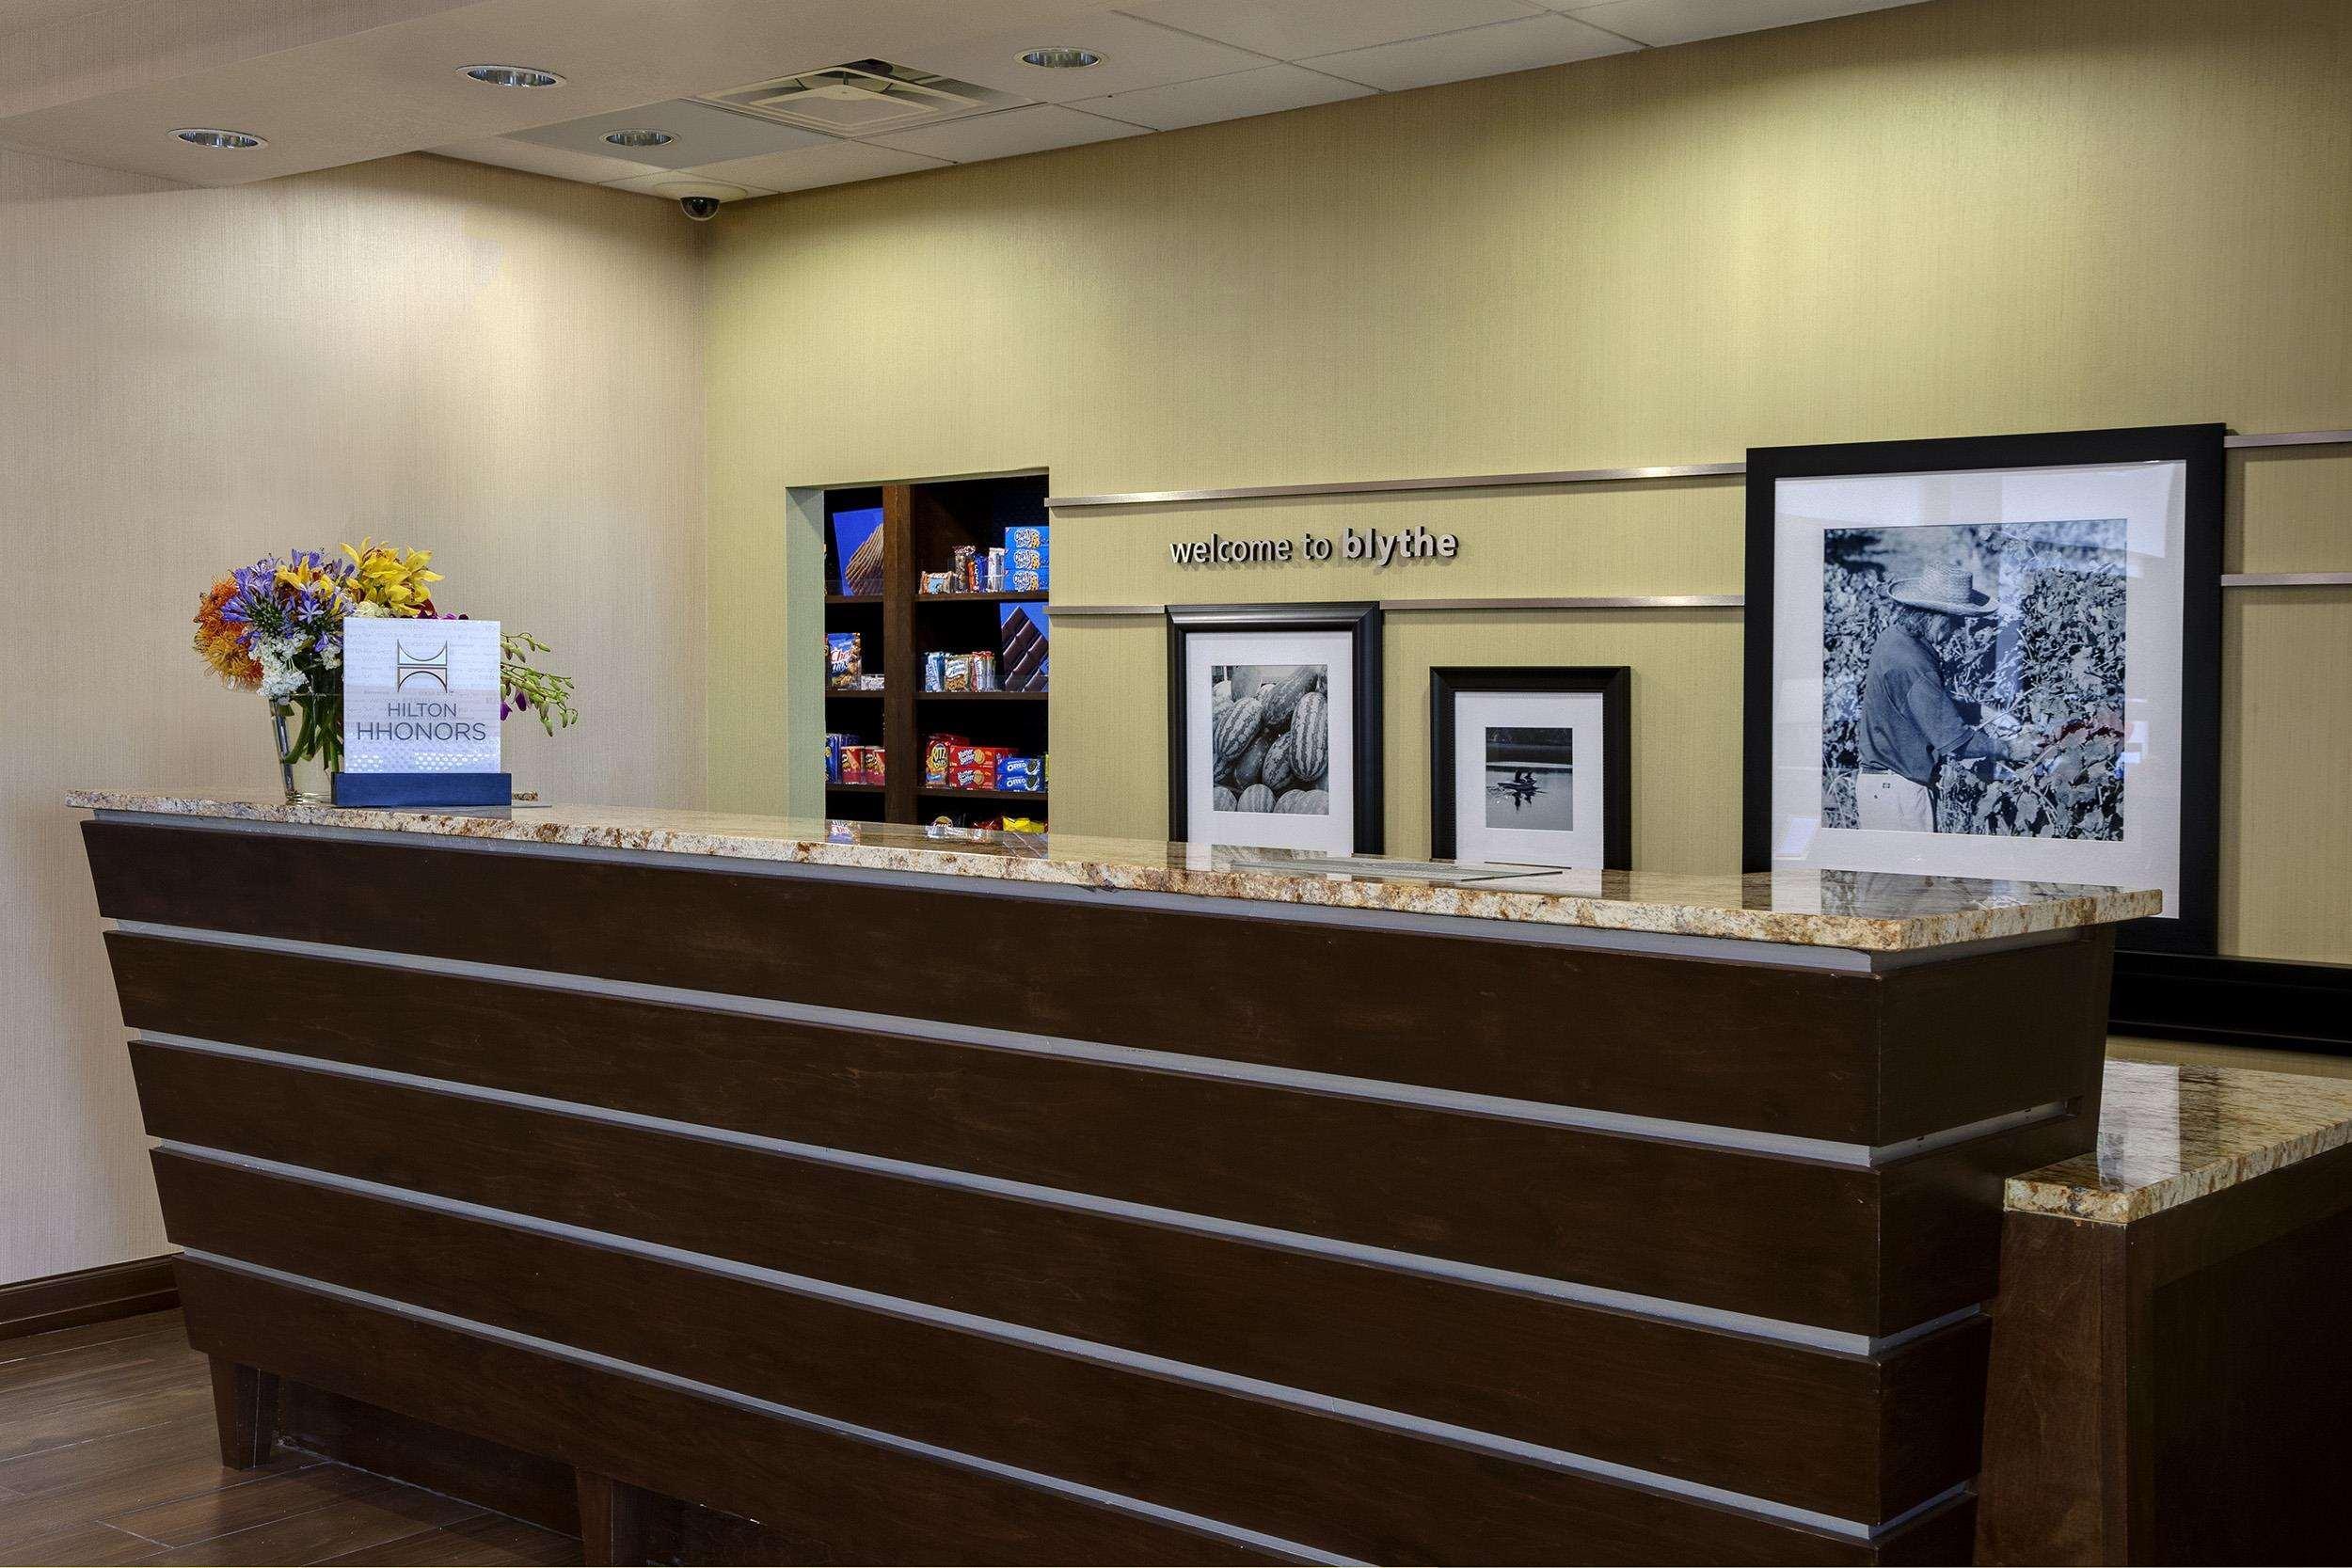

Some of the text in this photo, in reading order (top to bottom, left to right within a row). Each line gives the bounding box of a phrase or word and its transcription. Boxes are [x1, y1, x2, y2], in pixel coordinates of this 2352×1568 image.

[1169, 526, 1458, 566] welcome to blythe
[388, 703, 456, 718] HILTON
[358, 721, 486, 741] HHONORS
[1007, 763, 1026, 771] OREO
[1007, 778, 1026, 787] OREO
